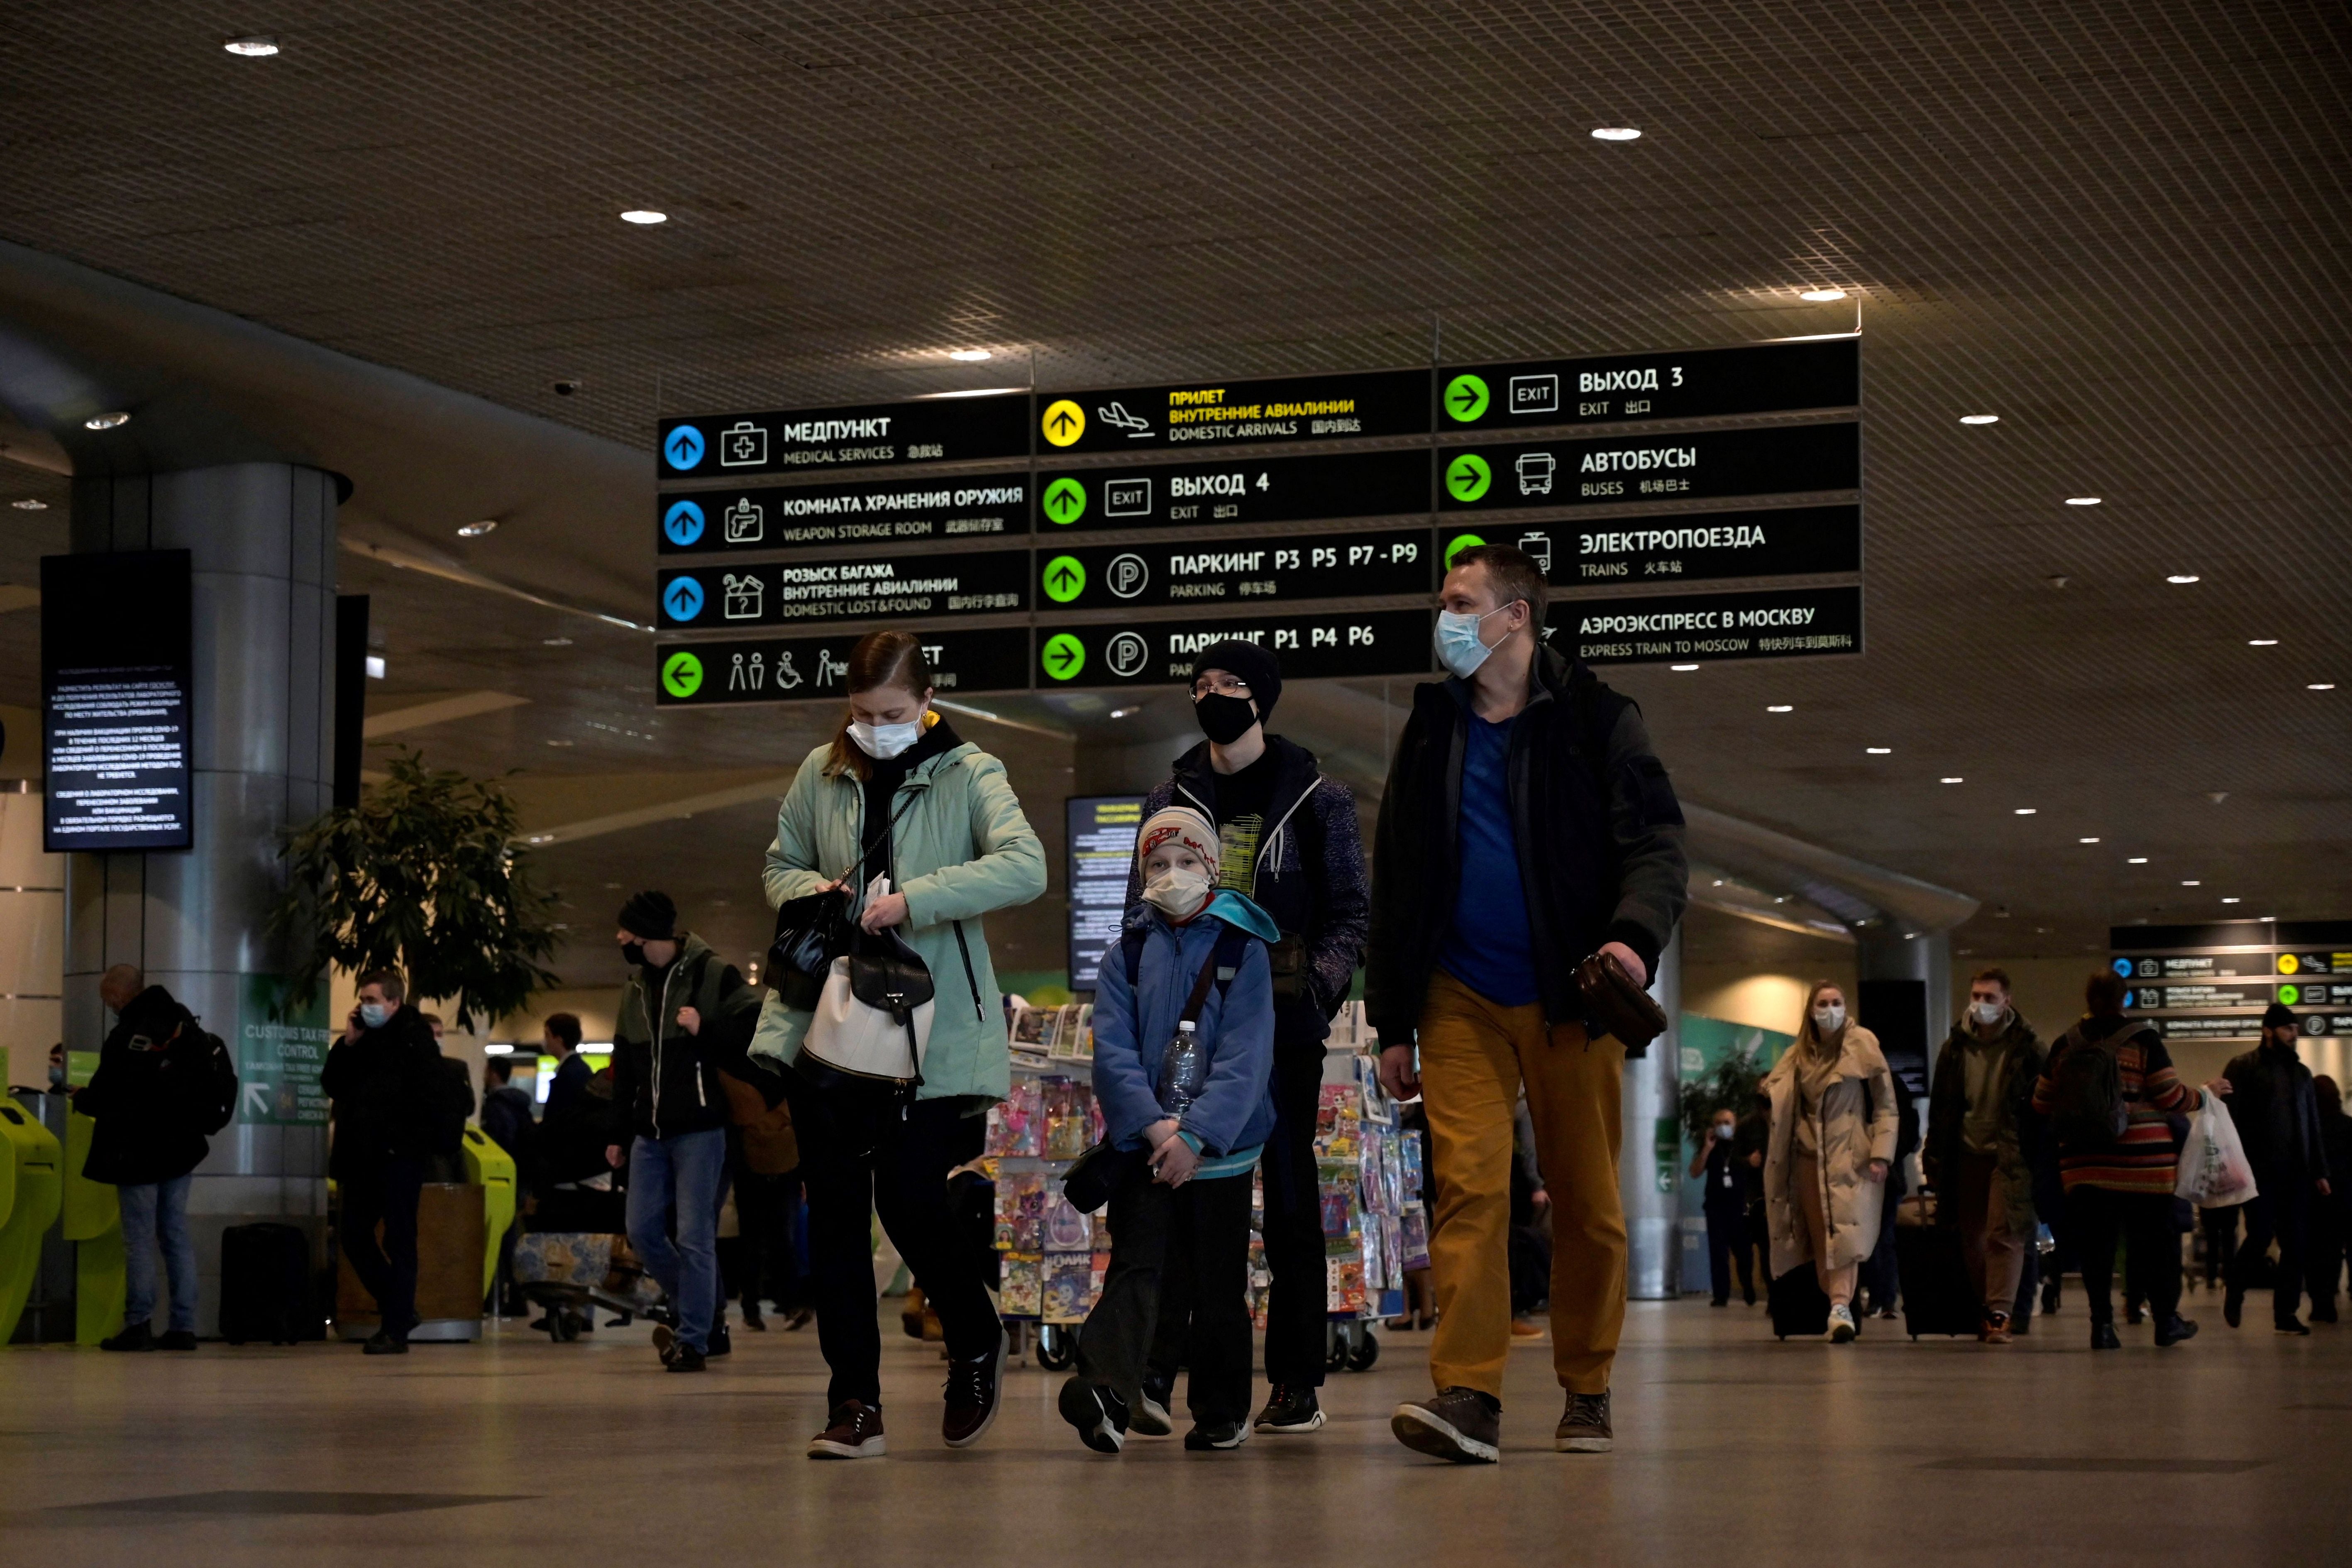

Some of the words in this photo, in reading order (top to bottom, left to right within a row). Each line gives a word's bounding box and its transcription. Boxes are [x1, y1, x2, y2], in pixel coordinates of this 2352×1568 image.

[1580, 369, 1658, 392] ВЫХОД
[1671, 367, 1683, 387] 3
[1169, 389, 1226, 405] ПРИЛЕТ
[1517, 386, 1550, 402] EXIT
[1169, 405, 1261, 424] ВНУТРЕННИЕ
[1264, 399, 1354, 418] АВИАЛИНИИ
[1580, 401, 1610, 416] EXIT
[1625, 400, 1651, 414] 出口
[784, 417, 891, 443] МЕДПУНКТ
[1169, 424, 1235, 442] DOMESTIC
[1236, 421, 1297, 437] ARRIVALS
[784, 450, 837, 464] MEDICAL
[838, 446, 894, 462] SERVICES
[1580, 447, 1696, 473] АВТОБУСЫ
[1171, 474, 1246, 497] ВЫХОД
[1256, 472, 1270, 491] 4
[1581, 481, 1624, 496] BUSES
[1639, 479, 1690, 493] 机场巴士
[784, 496, 862, 516] КОМНАТА
[865, 491, 950, 511] ХРАНЕНИЯ
[954, 487, 1023, 506] ОРУЖИЯ
[1112, 490, 1143, 505] EXIT
[1170, 505, 1199, 520] EXIT
[1213, 504, 1238, 518] 出口
[783, 527, 835, 541] WEAPON
[838, 523, 892, 538] STORAGE
[895, 521, 932, 535] ROOM
[1580, 525, 1766, 554] ЭЛЕКТРОПОЕЗДА
[1171, 551, 1265, 575] ПАРКИНГ
[1275, 550, 1300, 569] P3
[1312, 547, 1337, 567] P5
[1580, 562, 1628, 577] TRAINS
[1644, 560, 1682, 574] 火车站
[783, 567, 838, 583] РОЗЫСК
[840, 564, 894, 580] БАГАЖА
[783, 582, 870, 601] ВНУТРЕННИЕ
[872, 578, 958, 595] АВИАЛИНИИ
[1170, 582, 1225, 597] PARKING
[783, 601, 845, 617] DOMESTIC
[1580, 612, 1717, 634] АЭРОЭКСПРЕСС
[1722, 611, 1734, 628] В
[1739, 608, 1815, 627] МОСКВУ
[1275, 629, 1299, 649] P1
[1312, 627, 1338, 647] P4
[1349, 625, 1374, 646] P6
[1759, 635, 1852, 651] 特快列车到莫斯科
[1580, 643, 1633, 657] EXPRESS
[1635, 642, 1671, 655] TRAIN
[1674, 640, 1691, 653] TO
[1694, 638, 1749, 652] MOSCOW
